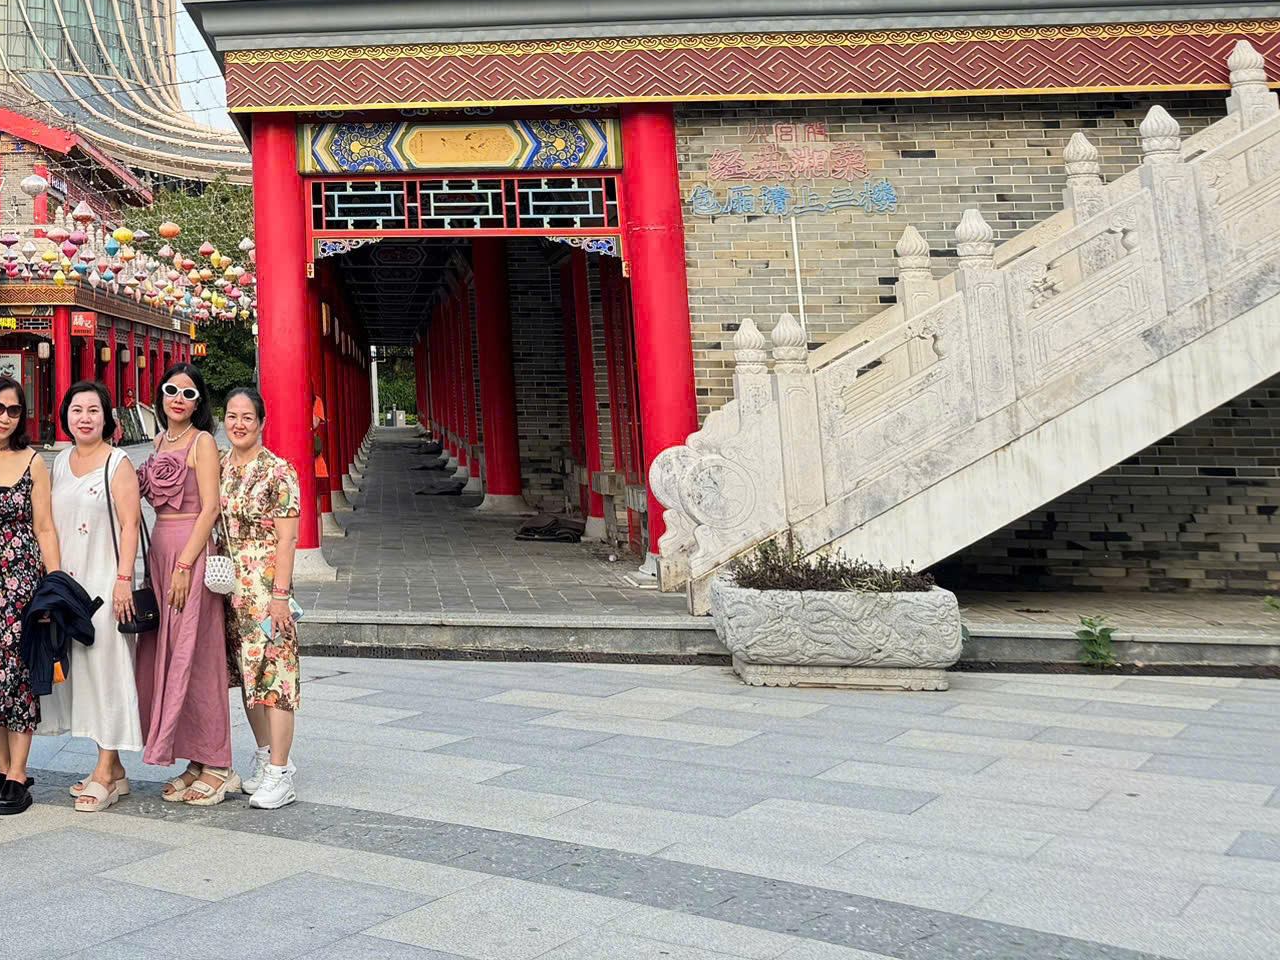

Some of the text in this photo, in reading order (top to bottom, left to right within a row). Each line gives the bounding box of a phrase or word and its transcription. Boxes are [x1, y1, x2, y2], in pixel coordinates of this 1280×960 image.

[708, 142, 870, 182] 经典湘菜
[686, 180, 899, 216] 包厢请上二楼
